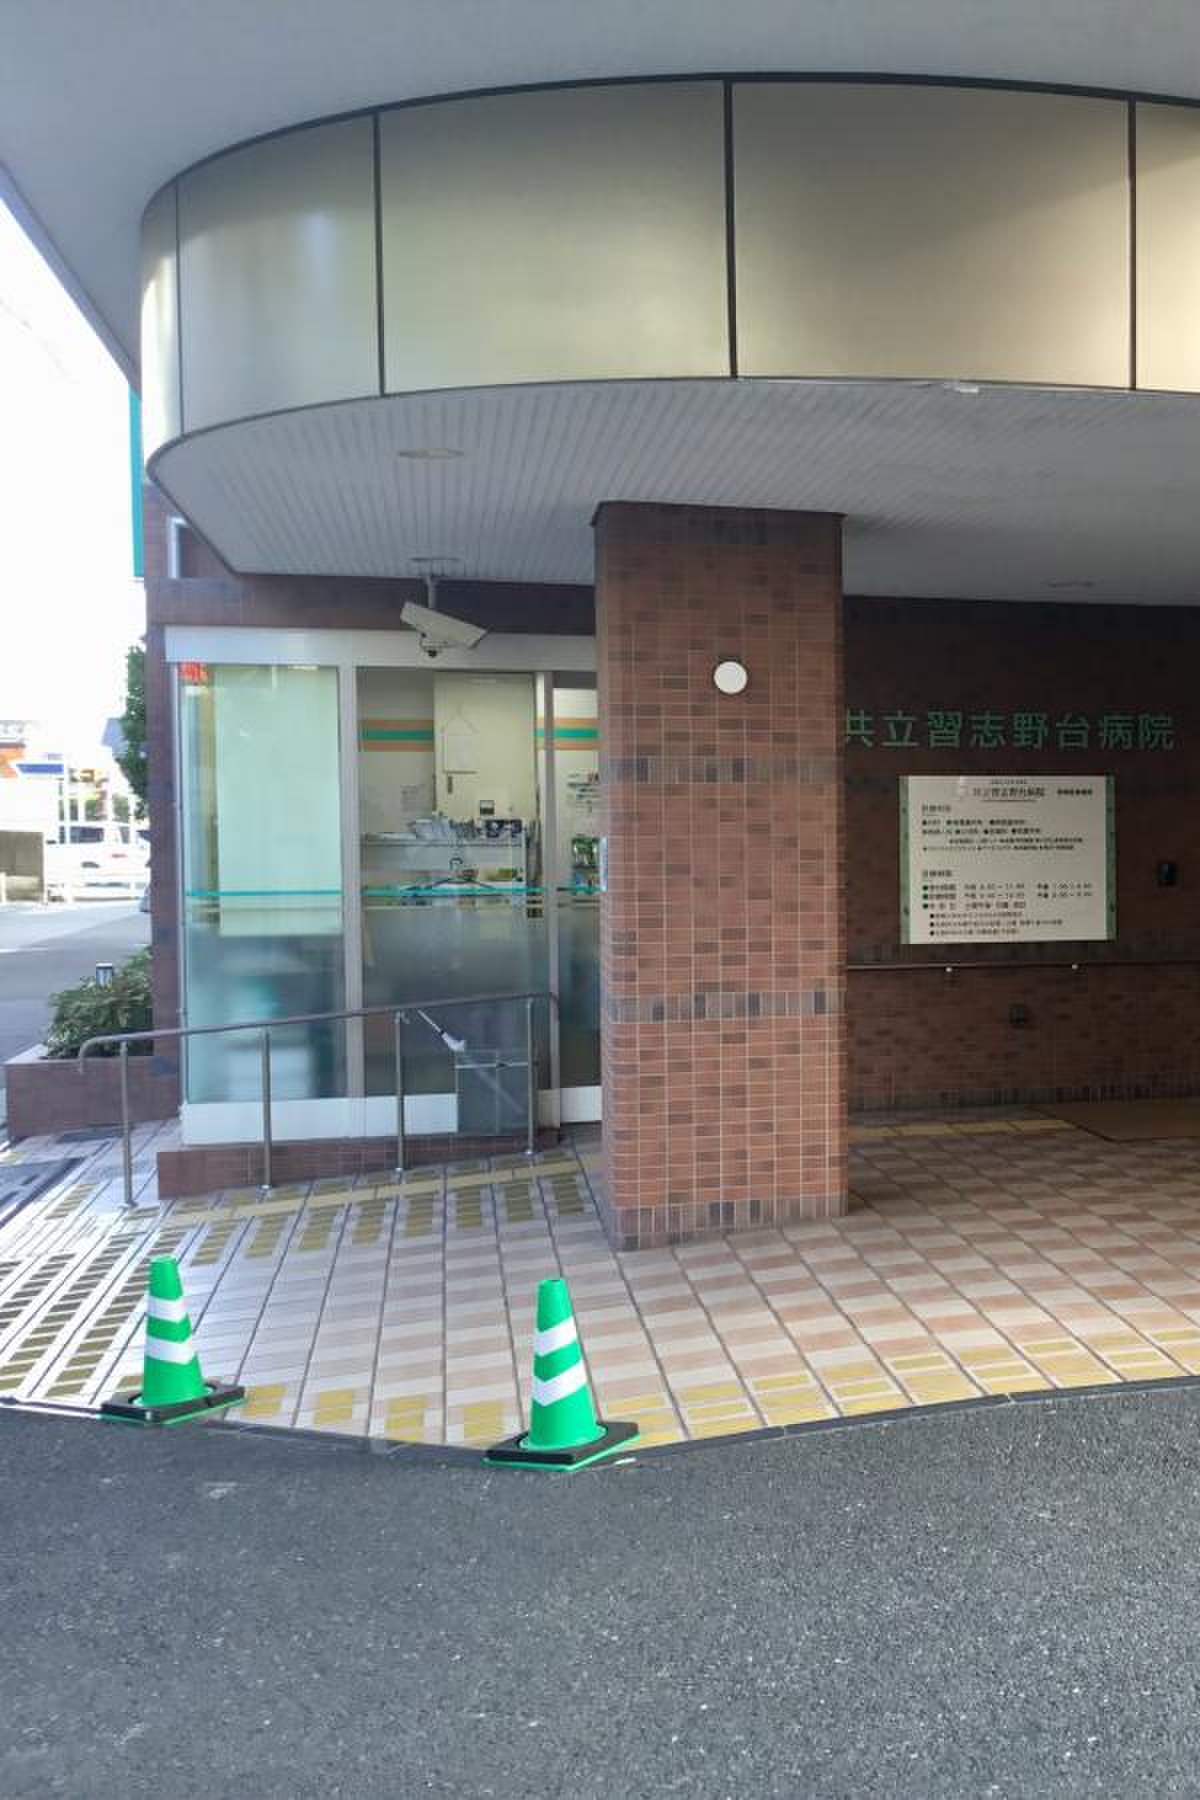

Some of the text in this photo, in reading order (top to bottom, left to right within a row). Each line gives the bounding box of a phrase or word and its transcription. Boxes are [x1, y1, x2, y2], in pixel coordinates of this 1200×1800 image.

[844, 708, 1174, 750] 共立習志野台病院
